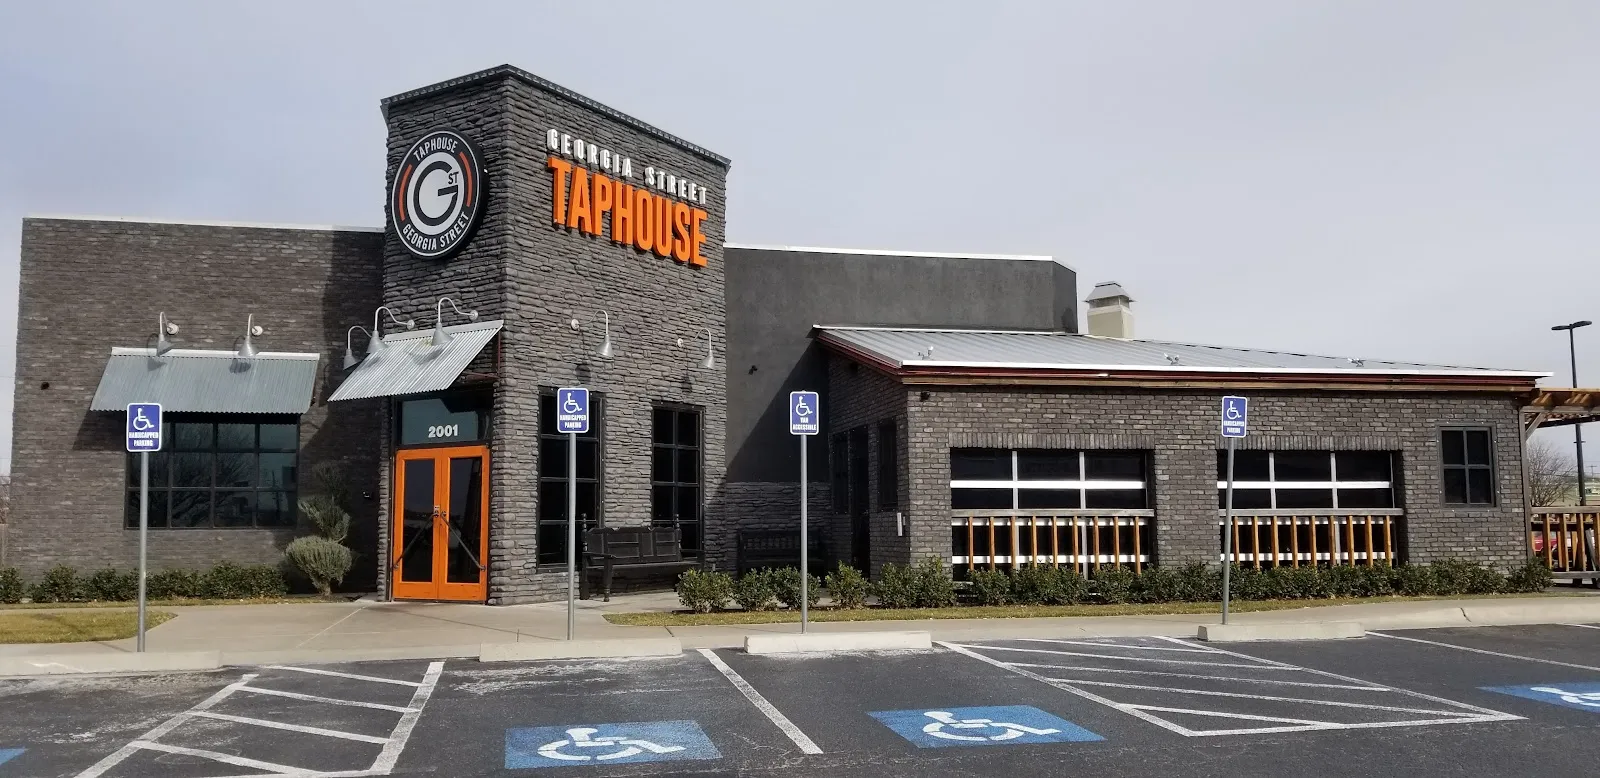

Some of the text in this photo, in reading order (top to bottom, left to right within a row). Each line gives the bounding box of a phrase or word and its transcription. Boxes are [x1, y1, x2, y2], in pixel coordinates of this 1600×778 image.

[413, 137, 458, 161] TAPHOUSE
[448, 171, 459, 184] ST
[547, 129, 707, 204] GEORGIA STREET
[548, 156, 708, 267] TAPHOUSE
[402, 211, 469, 250] GEORGIA STREET
[428, 424, 459, 438] 2001
